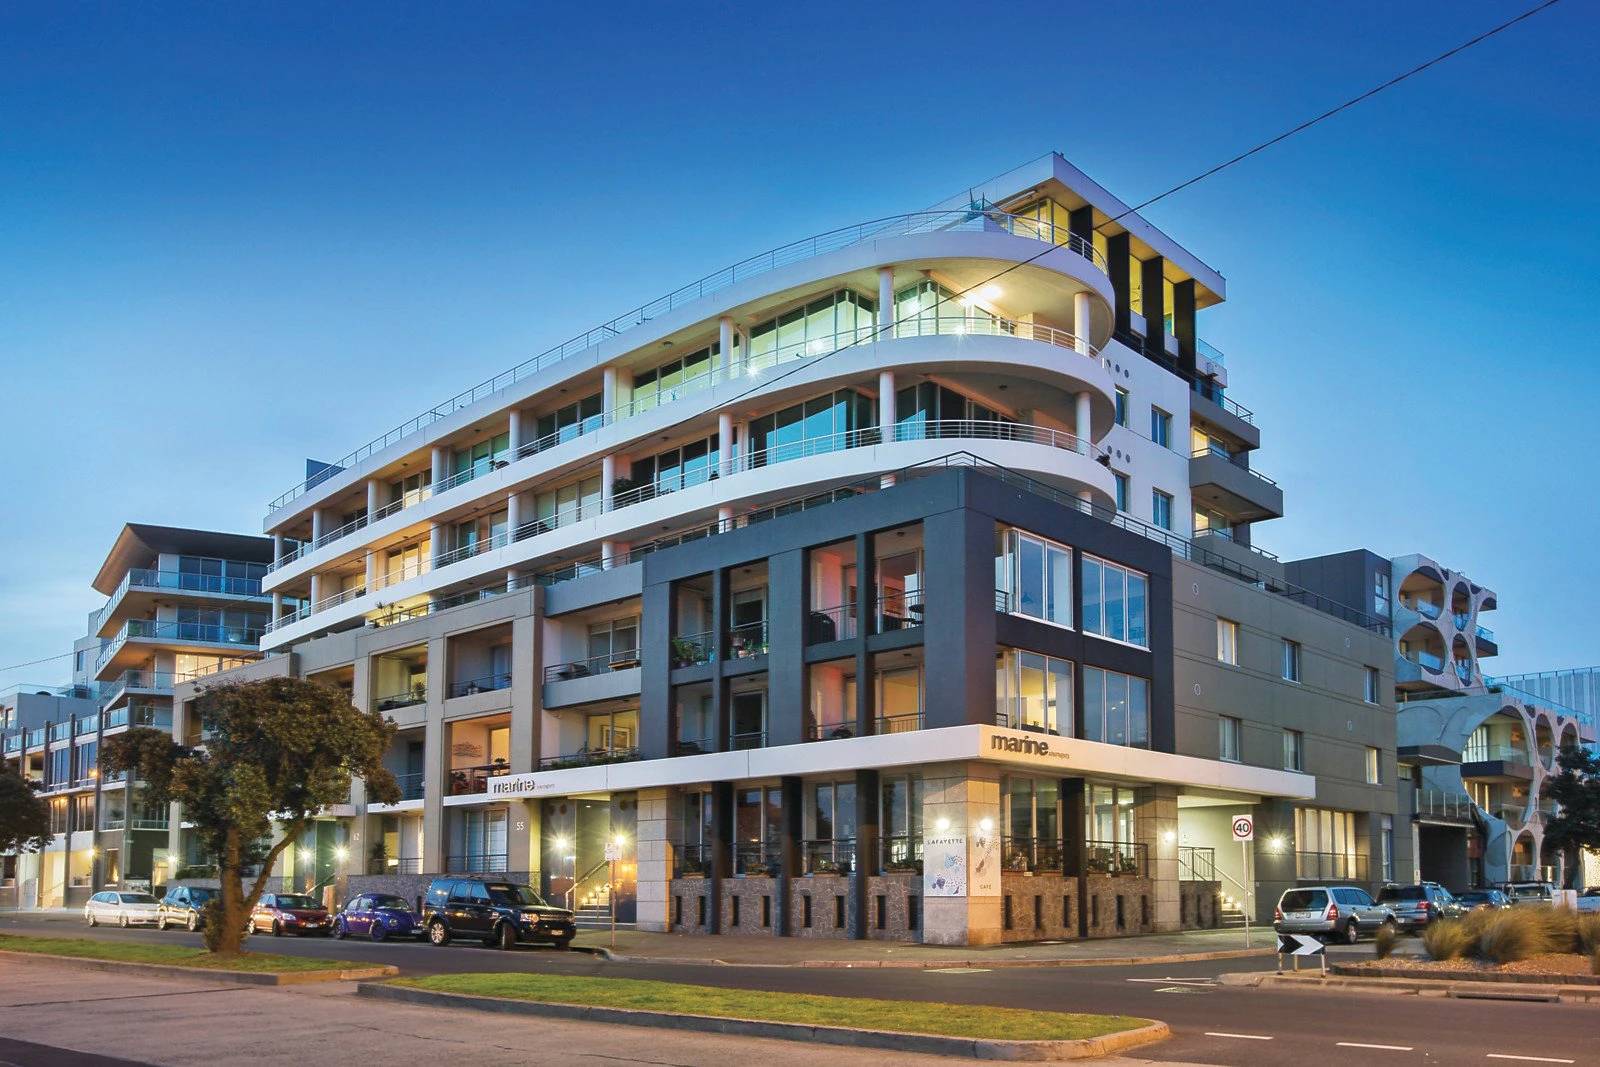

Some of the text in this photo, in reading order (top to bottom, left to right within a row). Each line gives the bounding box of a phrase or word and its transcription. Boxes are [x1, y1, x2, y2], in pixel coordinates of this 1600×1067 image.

[991, 735, 1049, 756] marine
[493, 778, 535, 794] marine
[516, 821, 524, 831] 55
[1236, 823, 1249, 832] 40
